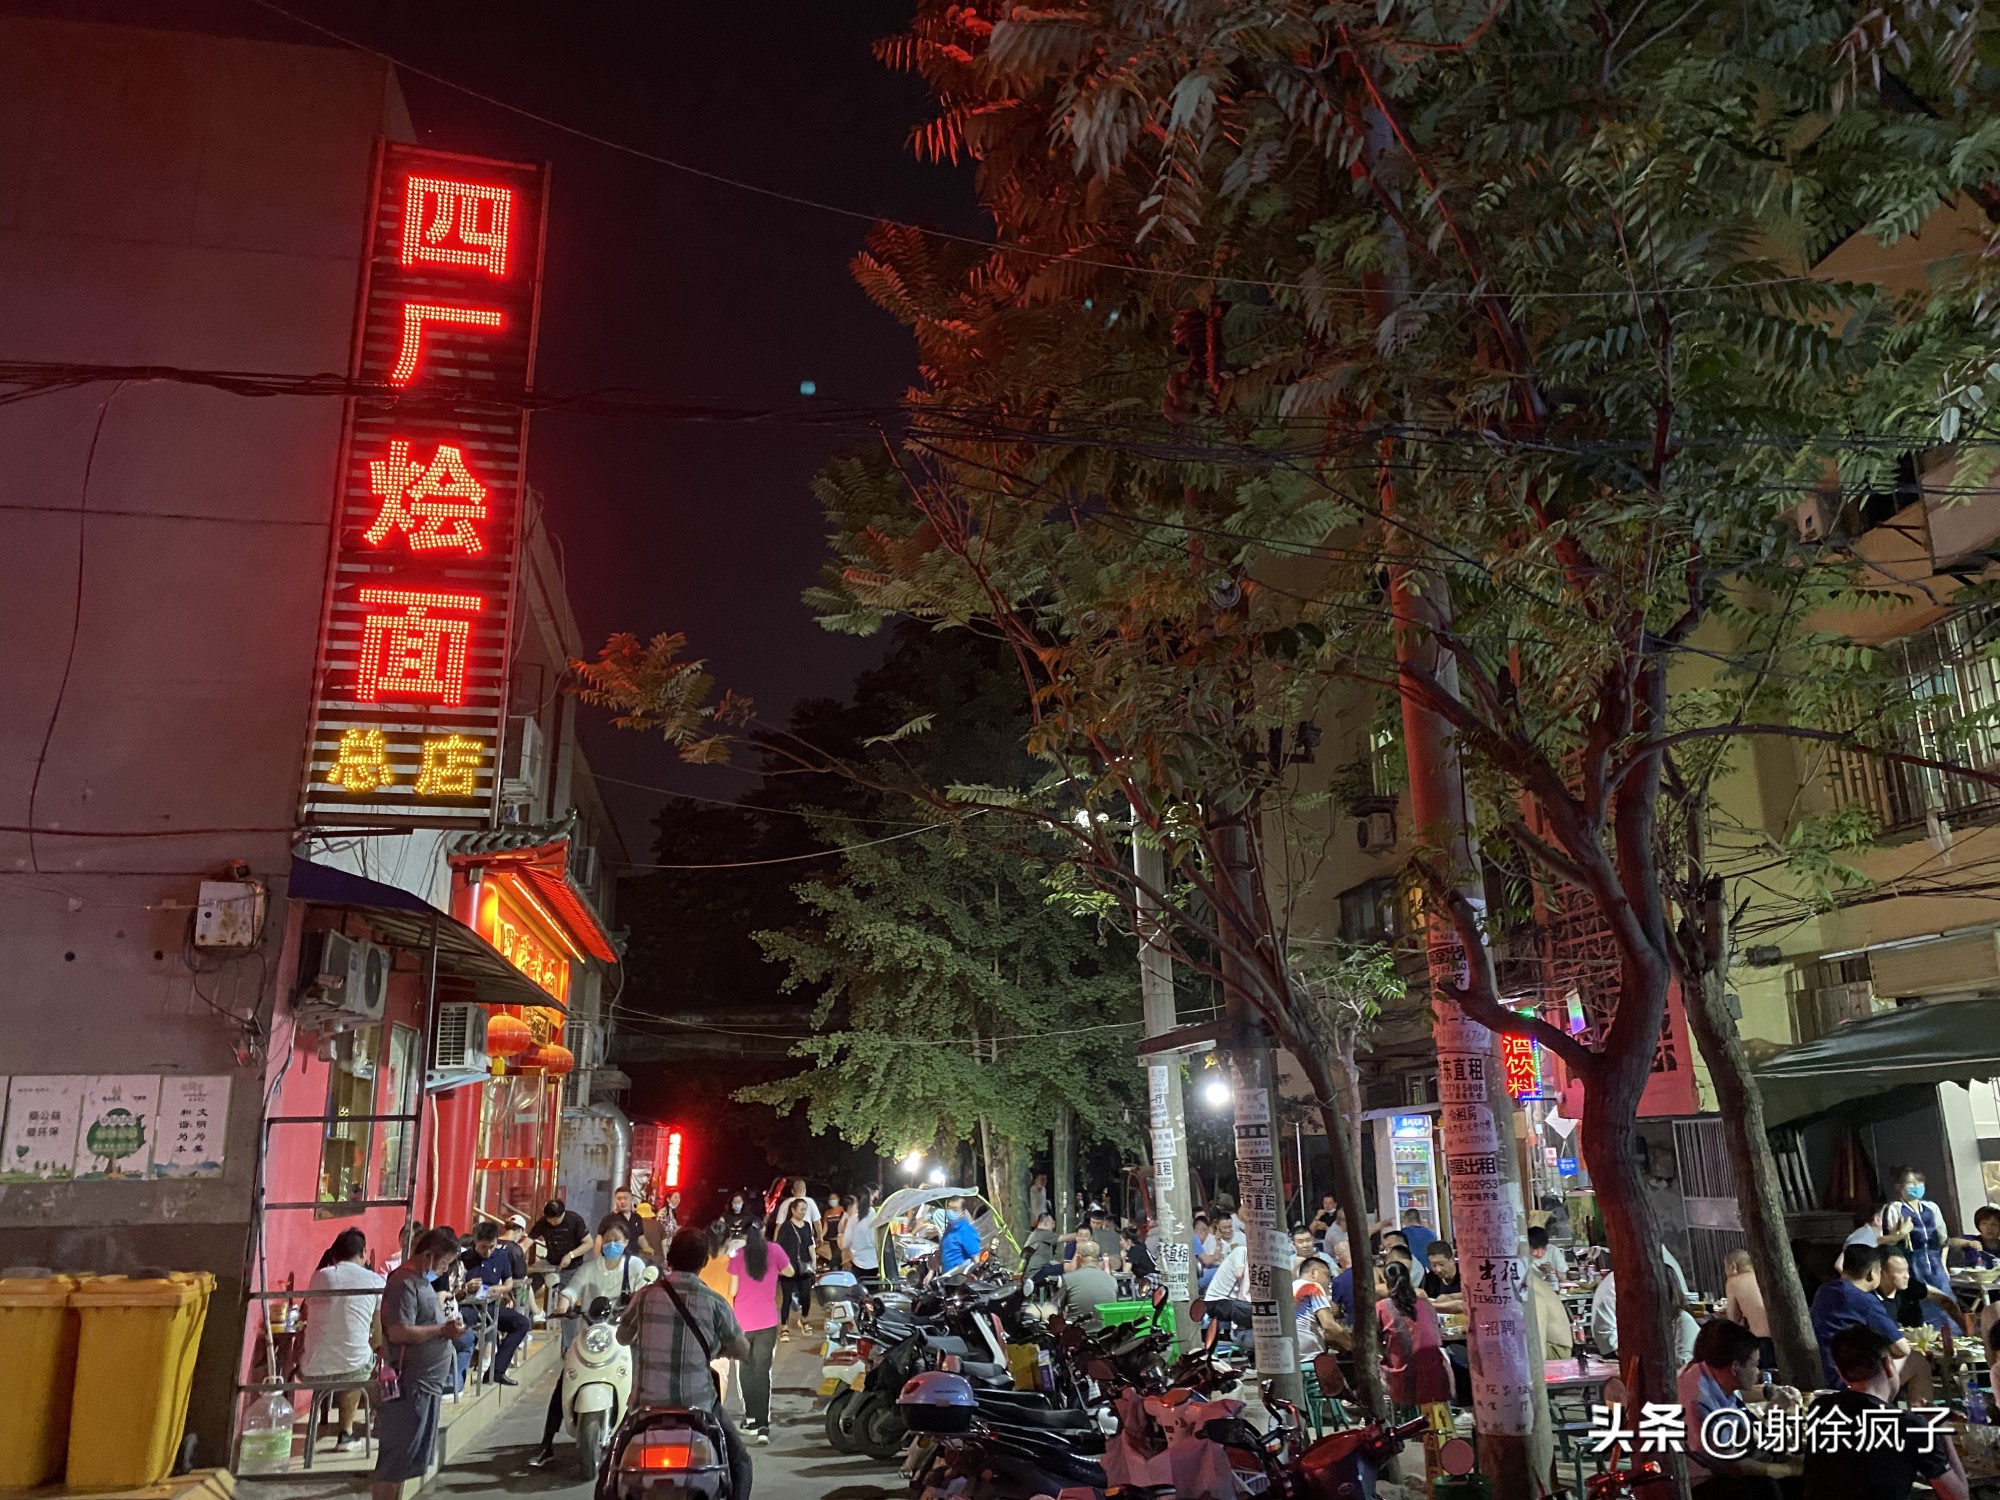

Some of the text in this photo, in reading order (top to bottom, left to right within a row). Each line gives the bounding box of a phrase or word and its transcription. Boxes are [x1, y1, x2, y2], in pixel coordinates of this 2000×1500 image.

[356, 175, 512, 705] 四厂烩面
[326, 727, 483, 797] 总店
[1439, 1058, 1484, 1081] 东直租
[1503, 1036, 1538, 1098] 酒饮料
[1479, 1259, 1521, 1282] 出租
